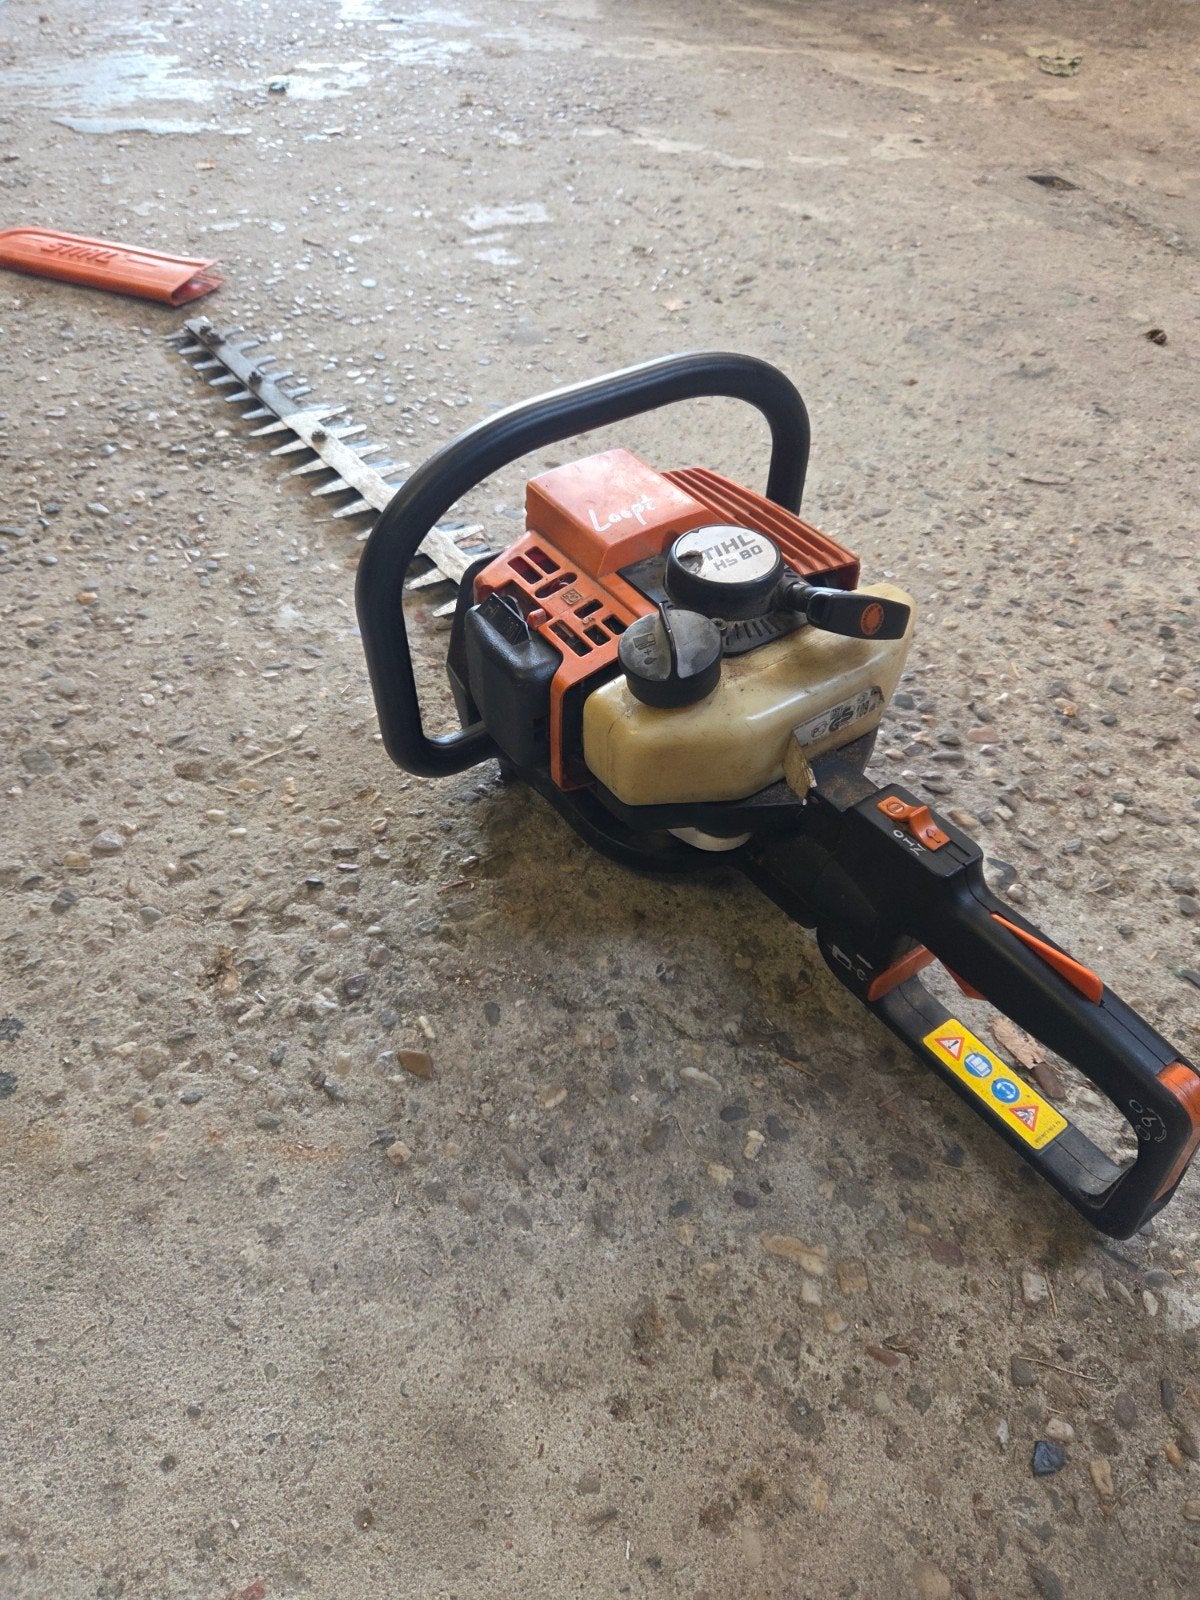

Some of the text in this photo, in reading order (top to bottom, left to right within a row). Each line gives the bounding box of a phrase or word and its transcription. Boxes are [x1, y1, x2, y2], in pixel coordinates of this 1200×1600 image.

[701, 535, 756, 561] TIHL
[713, 545, 763, 571] HS 80
